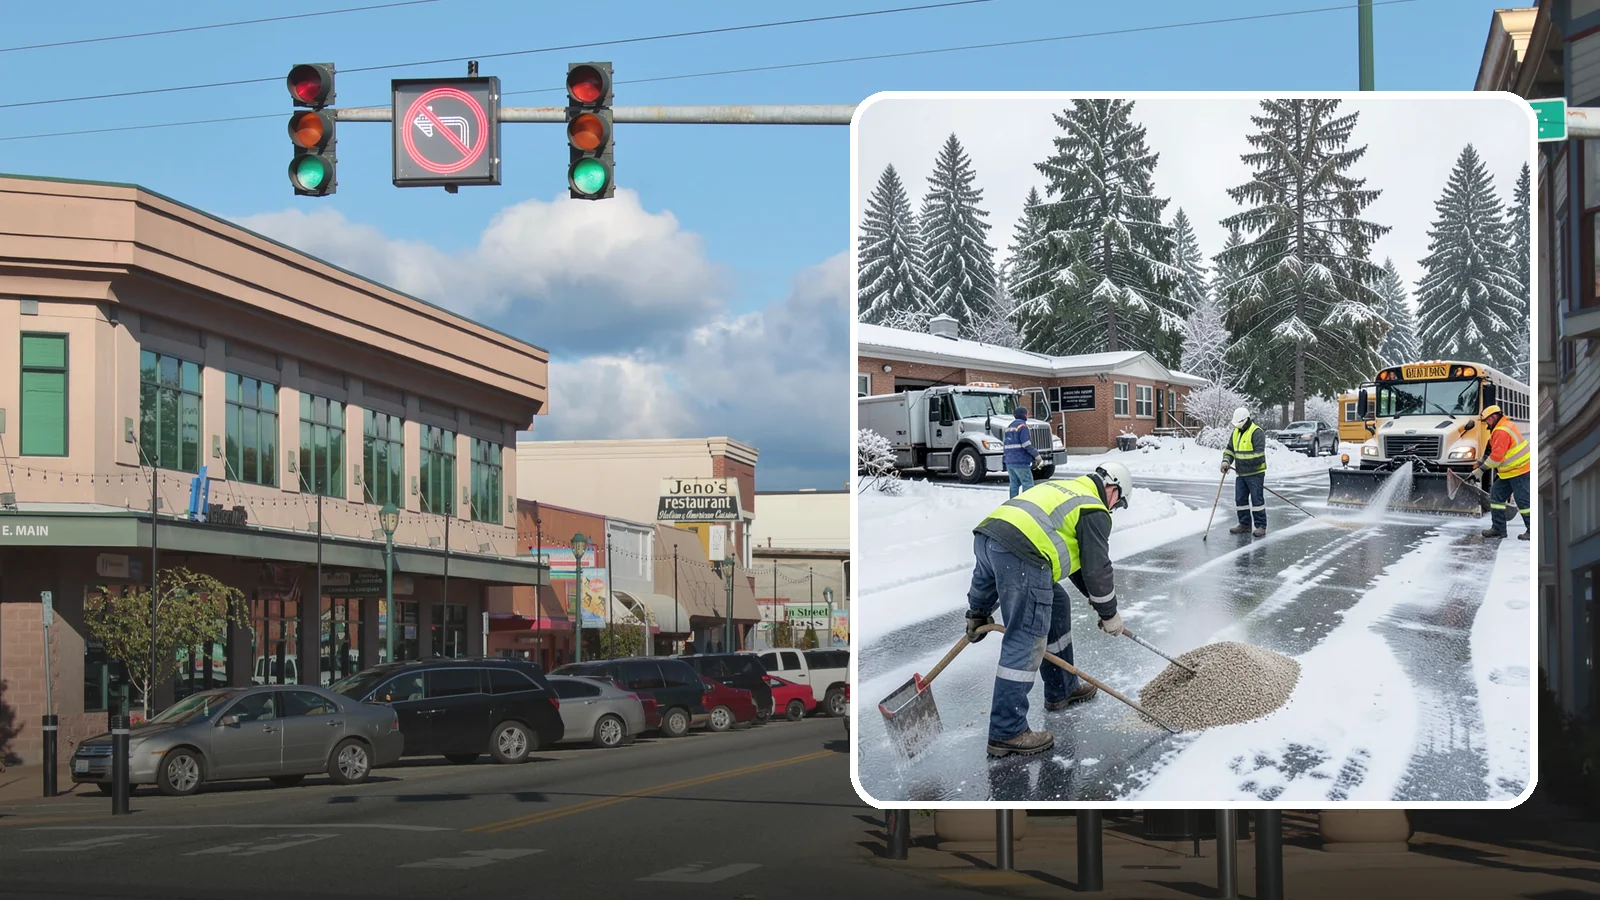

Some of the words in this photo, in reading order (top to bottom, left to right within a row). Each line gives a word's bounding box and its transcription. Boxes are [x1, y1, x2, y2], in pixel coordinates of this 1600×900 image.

[670, 480, 728, 494] Jeno's
[665, 497, 731, 509] restaurant
[686, 509, 714, 519] American
[715, 509, 737, 519] Cuisine
[2, 525, 13, 536] E.
[15, 525, 49, 536] MAIN
[797, 607, 828, 616] Street
[790, 619, 823, 627] lass
